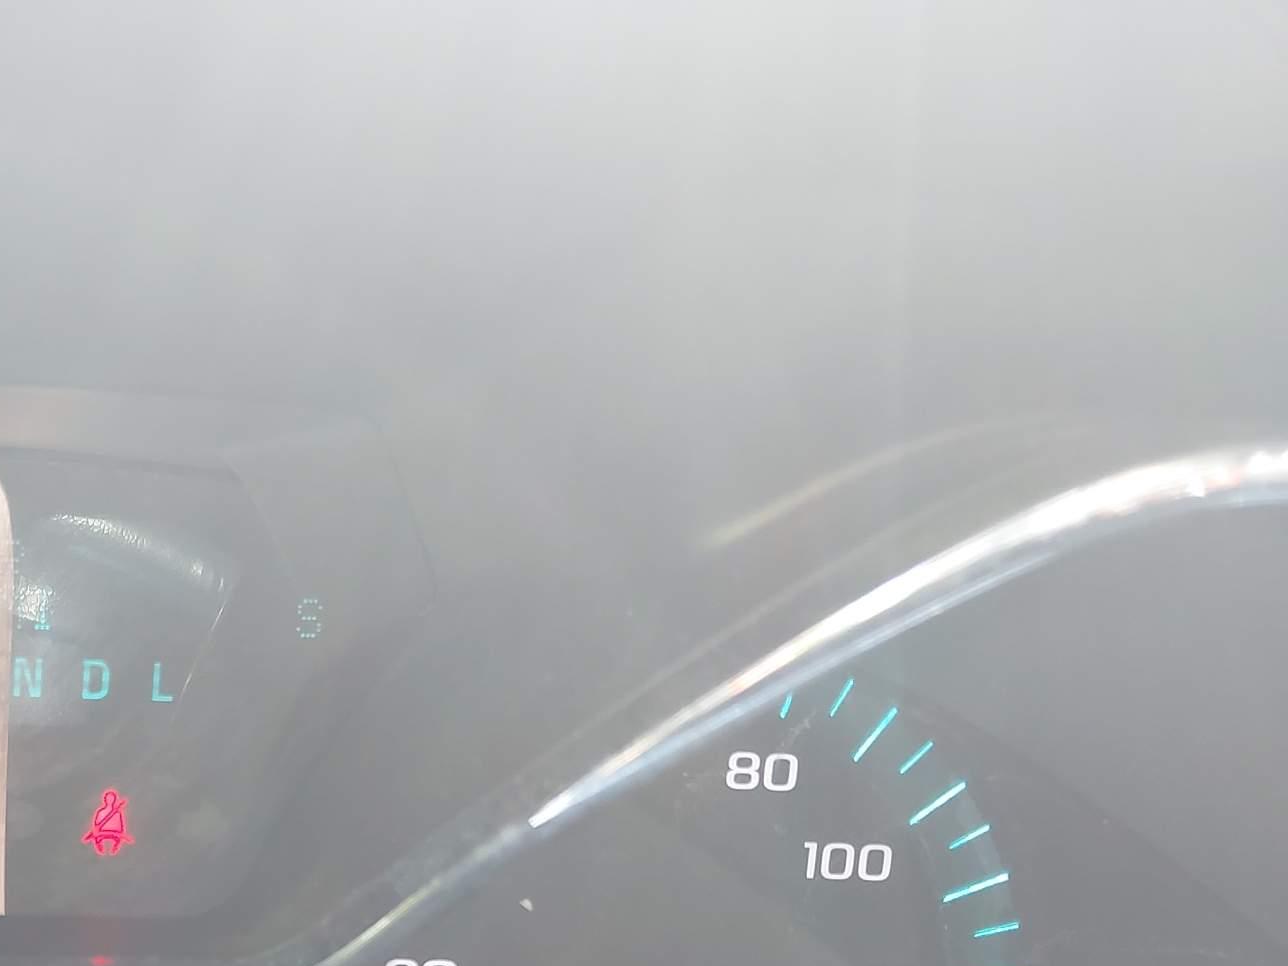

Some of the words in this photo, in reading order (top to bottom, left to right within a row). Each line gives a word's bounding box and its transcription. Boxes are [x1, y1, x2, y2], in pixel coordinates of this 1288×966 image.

[295, 596, 325, 640] S
[12, 656, 44, 698] N
[81, 658, 111, 701] D
[150, 660, 175, 703] L
[725, 751, 799, 792] 80
[802, 841, 893, 882] 100
